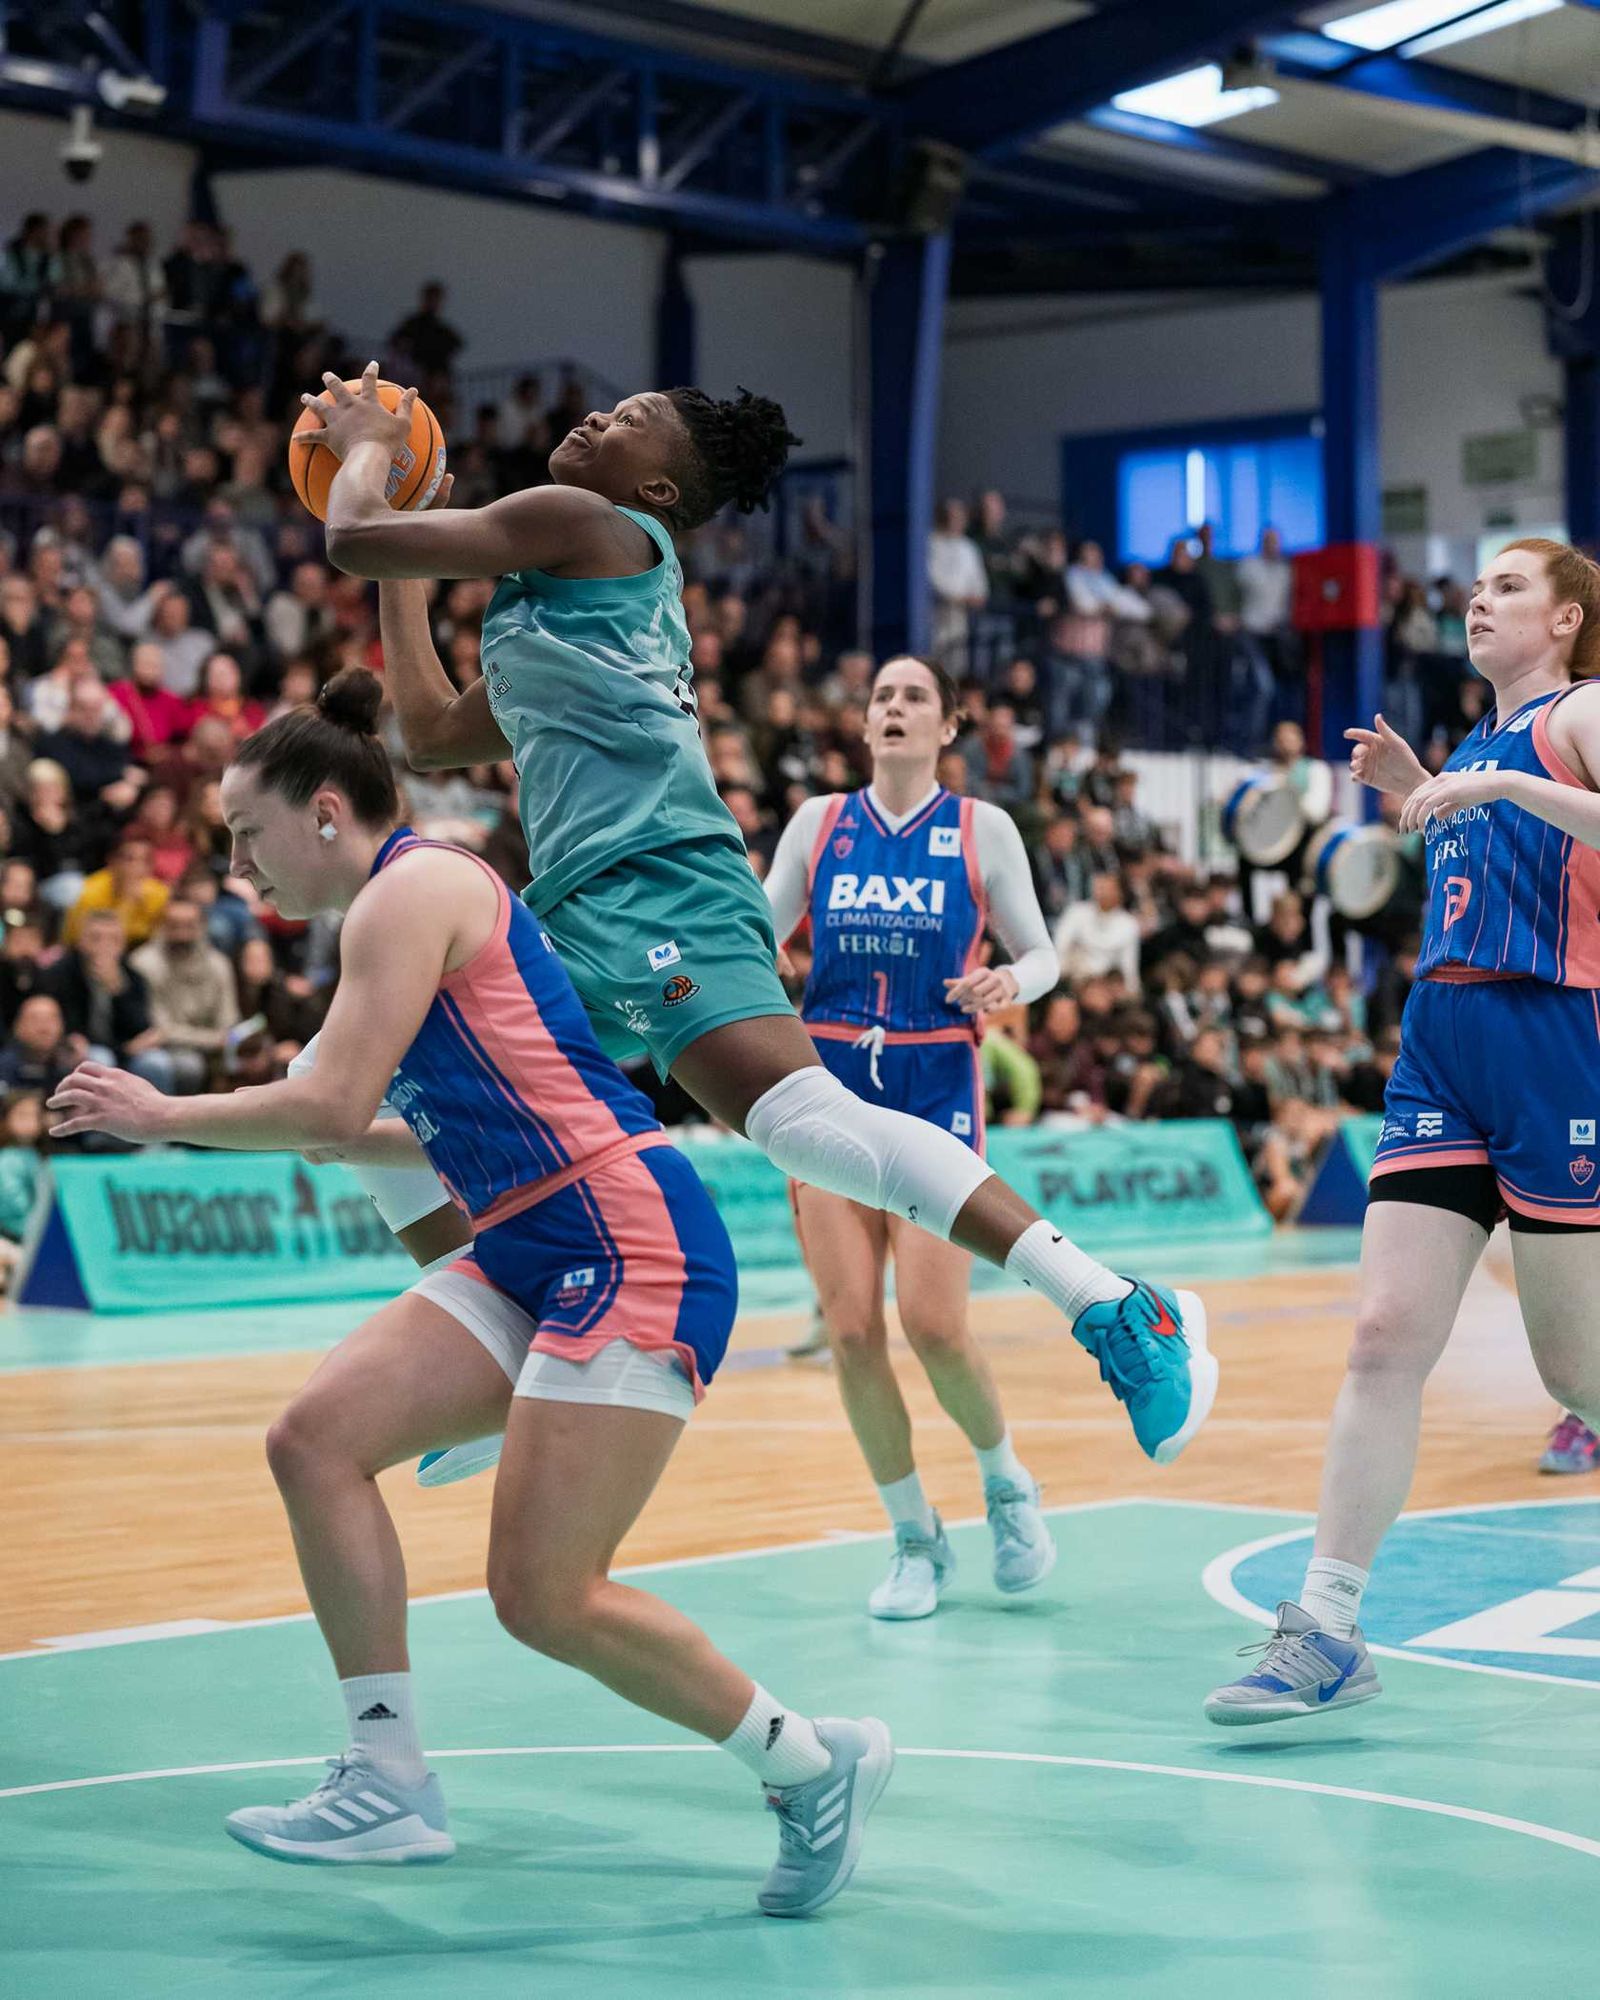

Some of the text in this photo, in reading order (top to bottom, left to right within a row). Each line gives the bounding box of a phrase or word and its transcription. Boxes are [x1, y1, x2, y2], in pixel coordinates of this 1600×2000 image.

[828, 874, 945, 915] BAXI
[826, 911, 943, 933] CLIMATIZACIÓN
[872, 971, 889, 1017] 1
